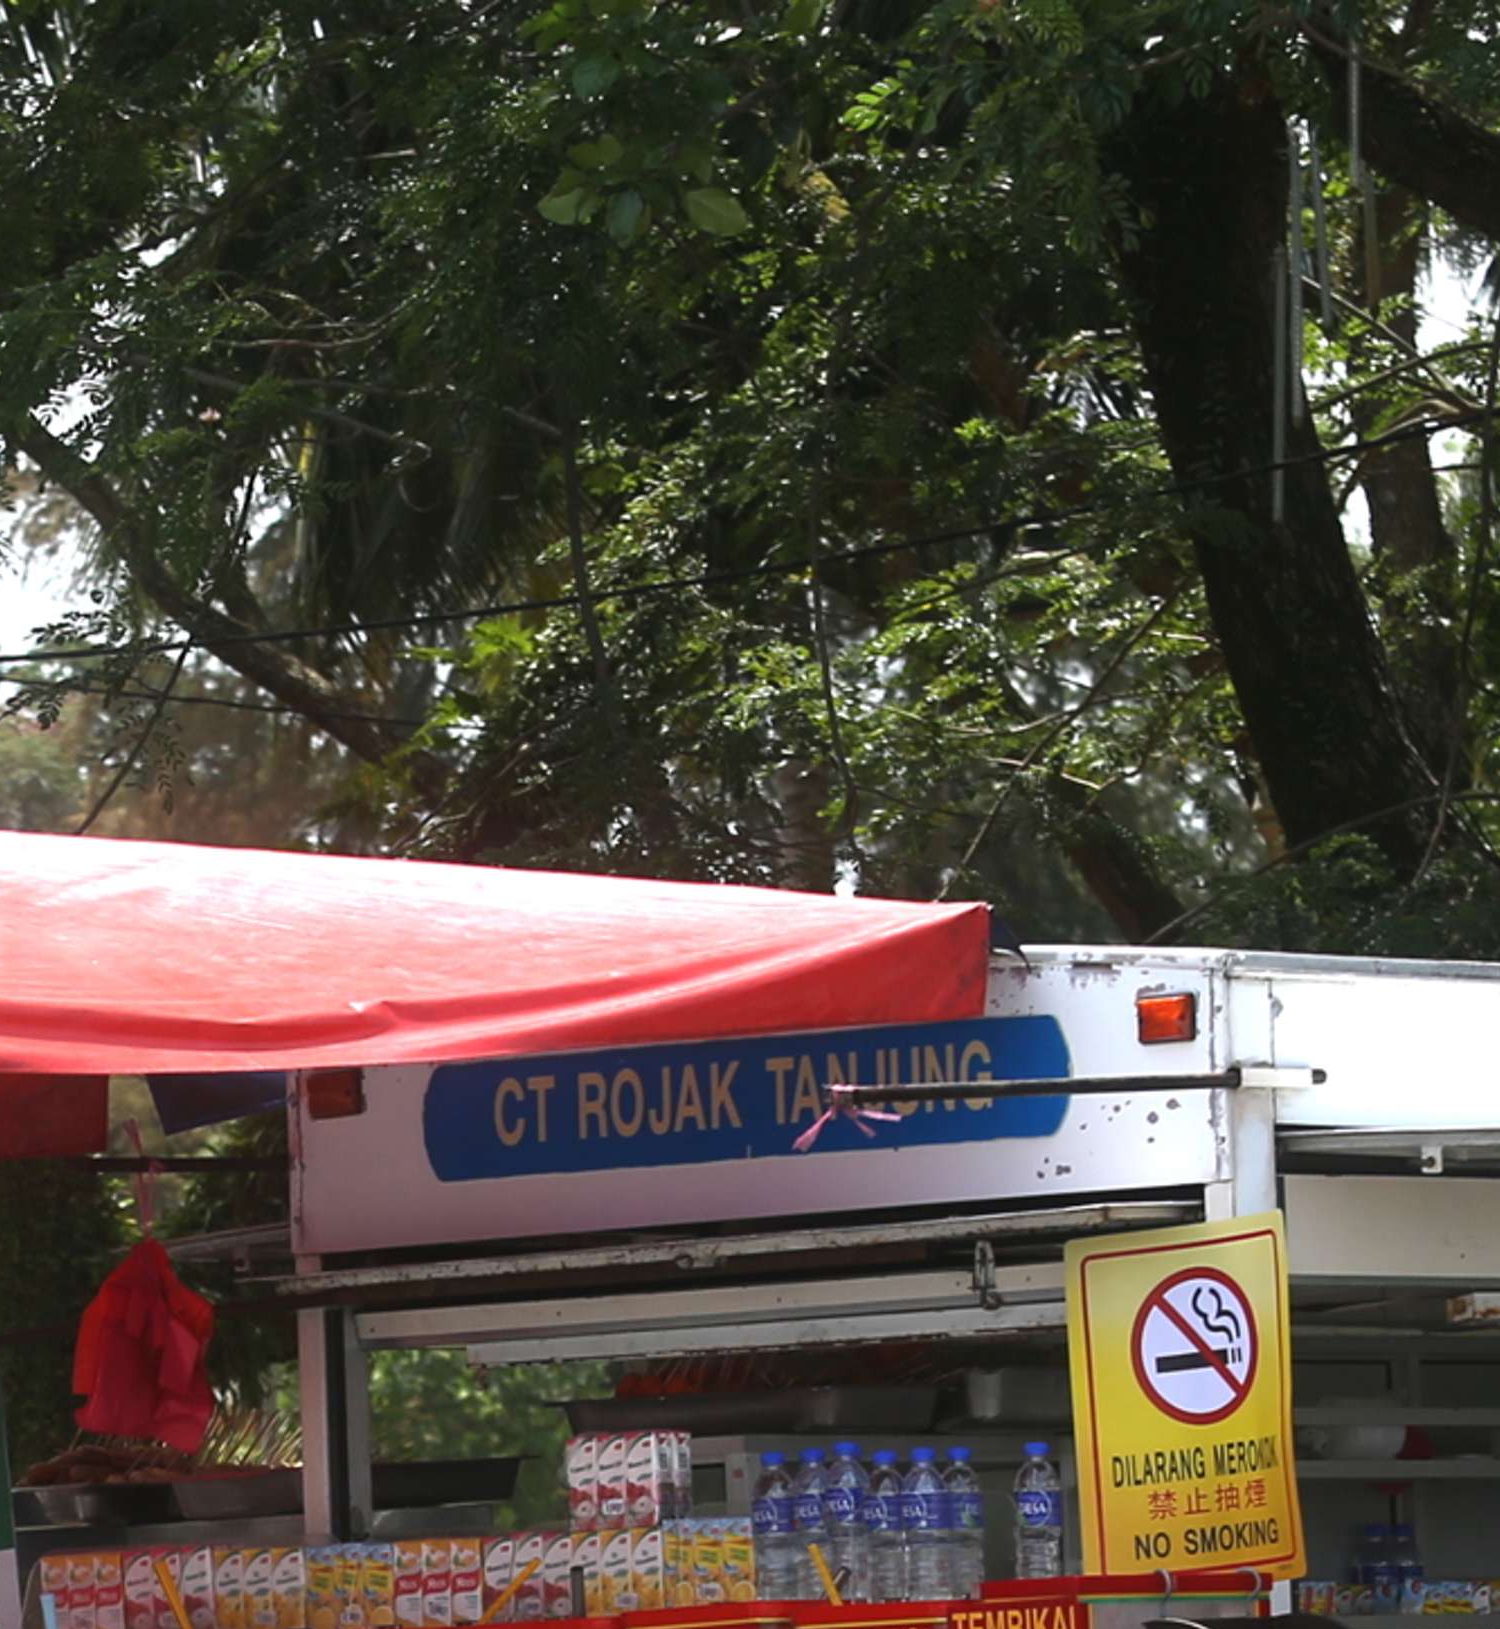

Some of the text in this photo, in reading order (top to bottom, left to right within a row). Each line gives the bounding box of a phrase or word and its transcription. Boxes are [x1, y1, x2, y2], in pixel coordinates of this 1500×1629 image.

[493, 1075, 556, 1147] CT
[577, 1060, 743, 1141] ROJAK
[1111, 1447, 1206, 1488] DILARANG
[1148, 1477, 1269, 1521] 禁止抽煙
[1134, 1517, 1279, 1560] NO SMOKING
